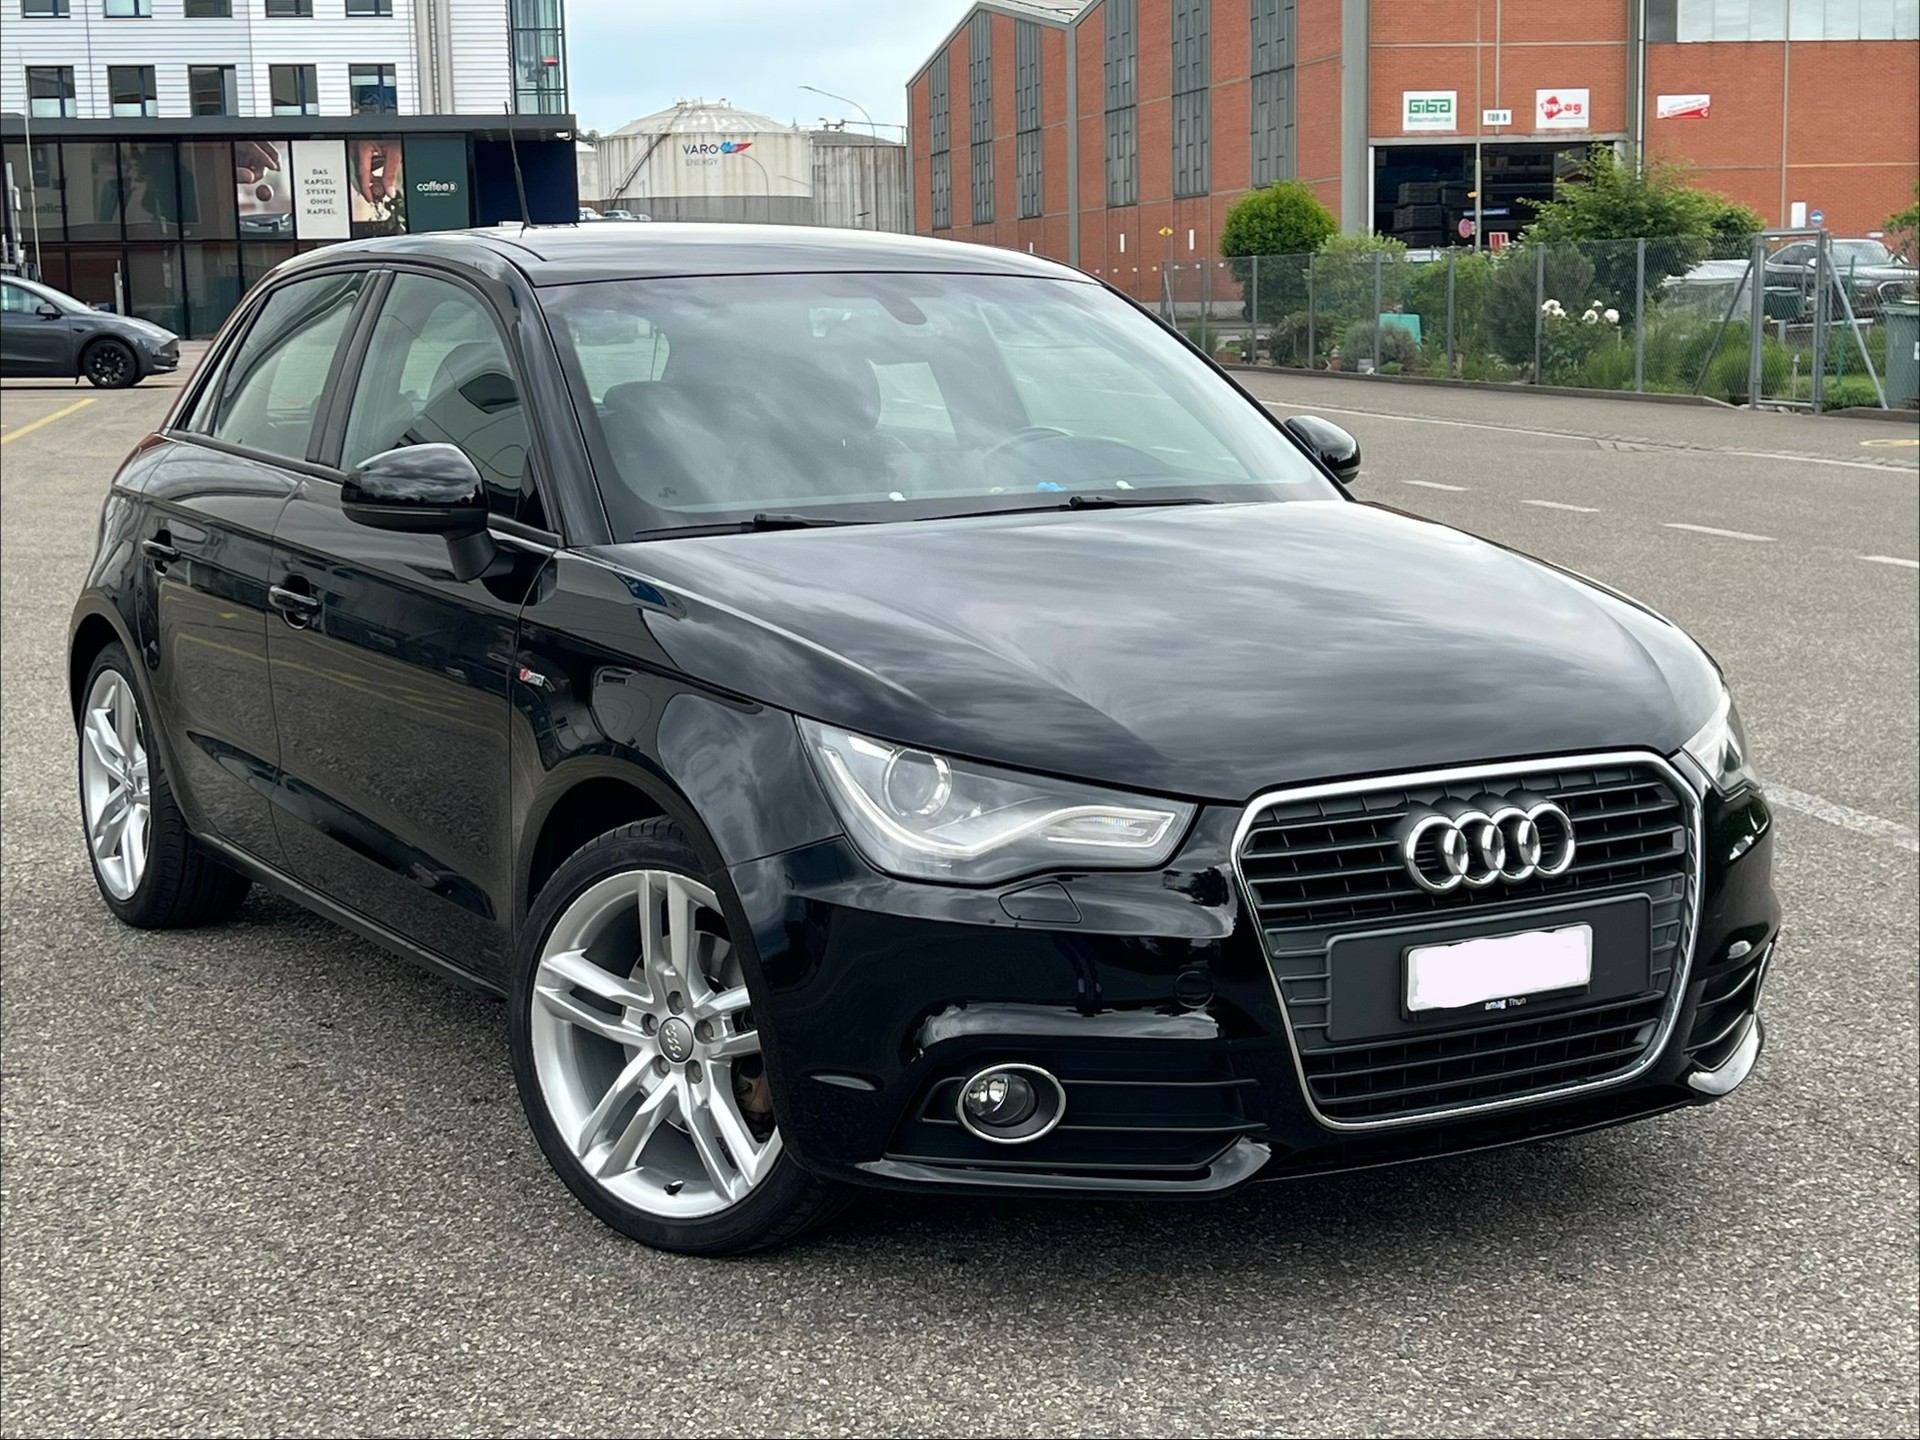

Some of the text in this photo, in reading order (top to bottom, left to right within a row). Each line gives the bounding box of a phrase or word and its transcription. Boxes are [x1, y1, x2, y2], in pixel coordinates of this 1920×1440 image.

[682, 144, 719, 155] VARO
[685, 158, 718, 167] ENERGY
[1508, 997, 1527, 1007] Thun
